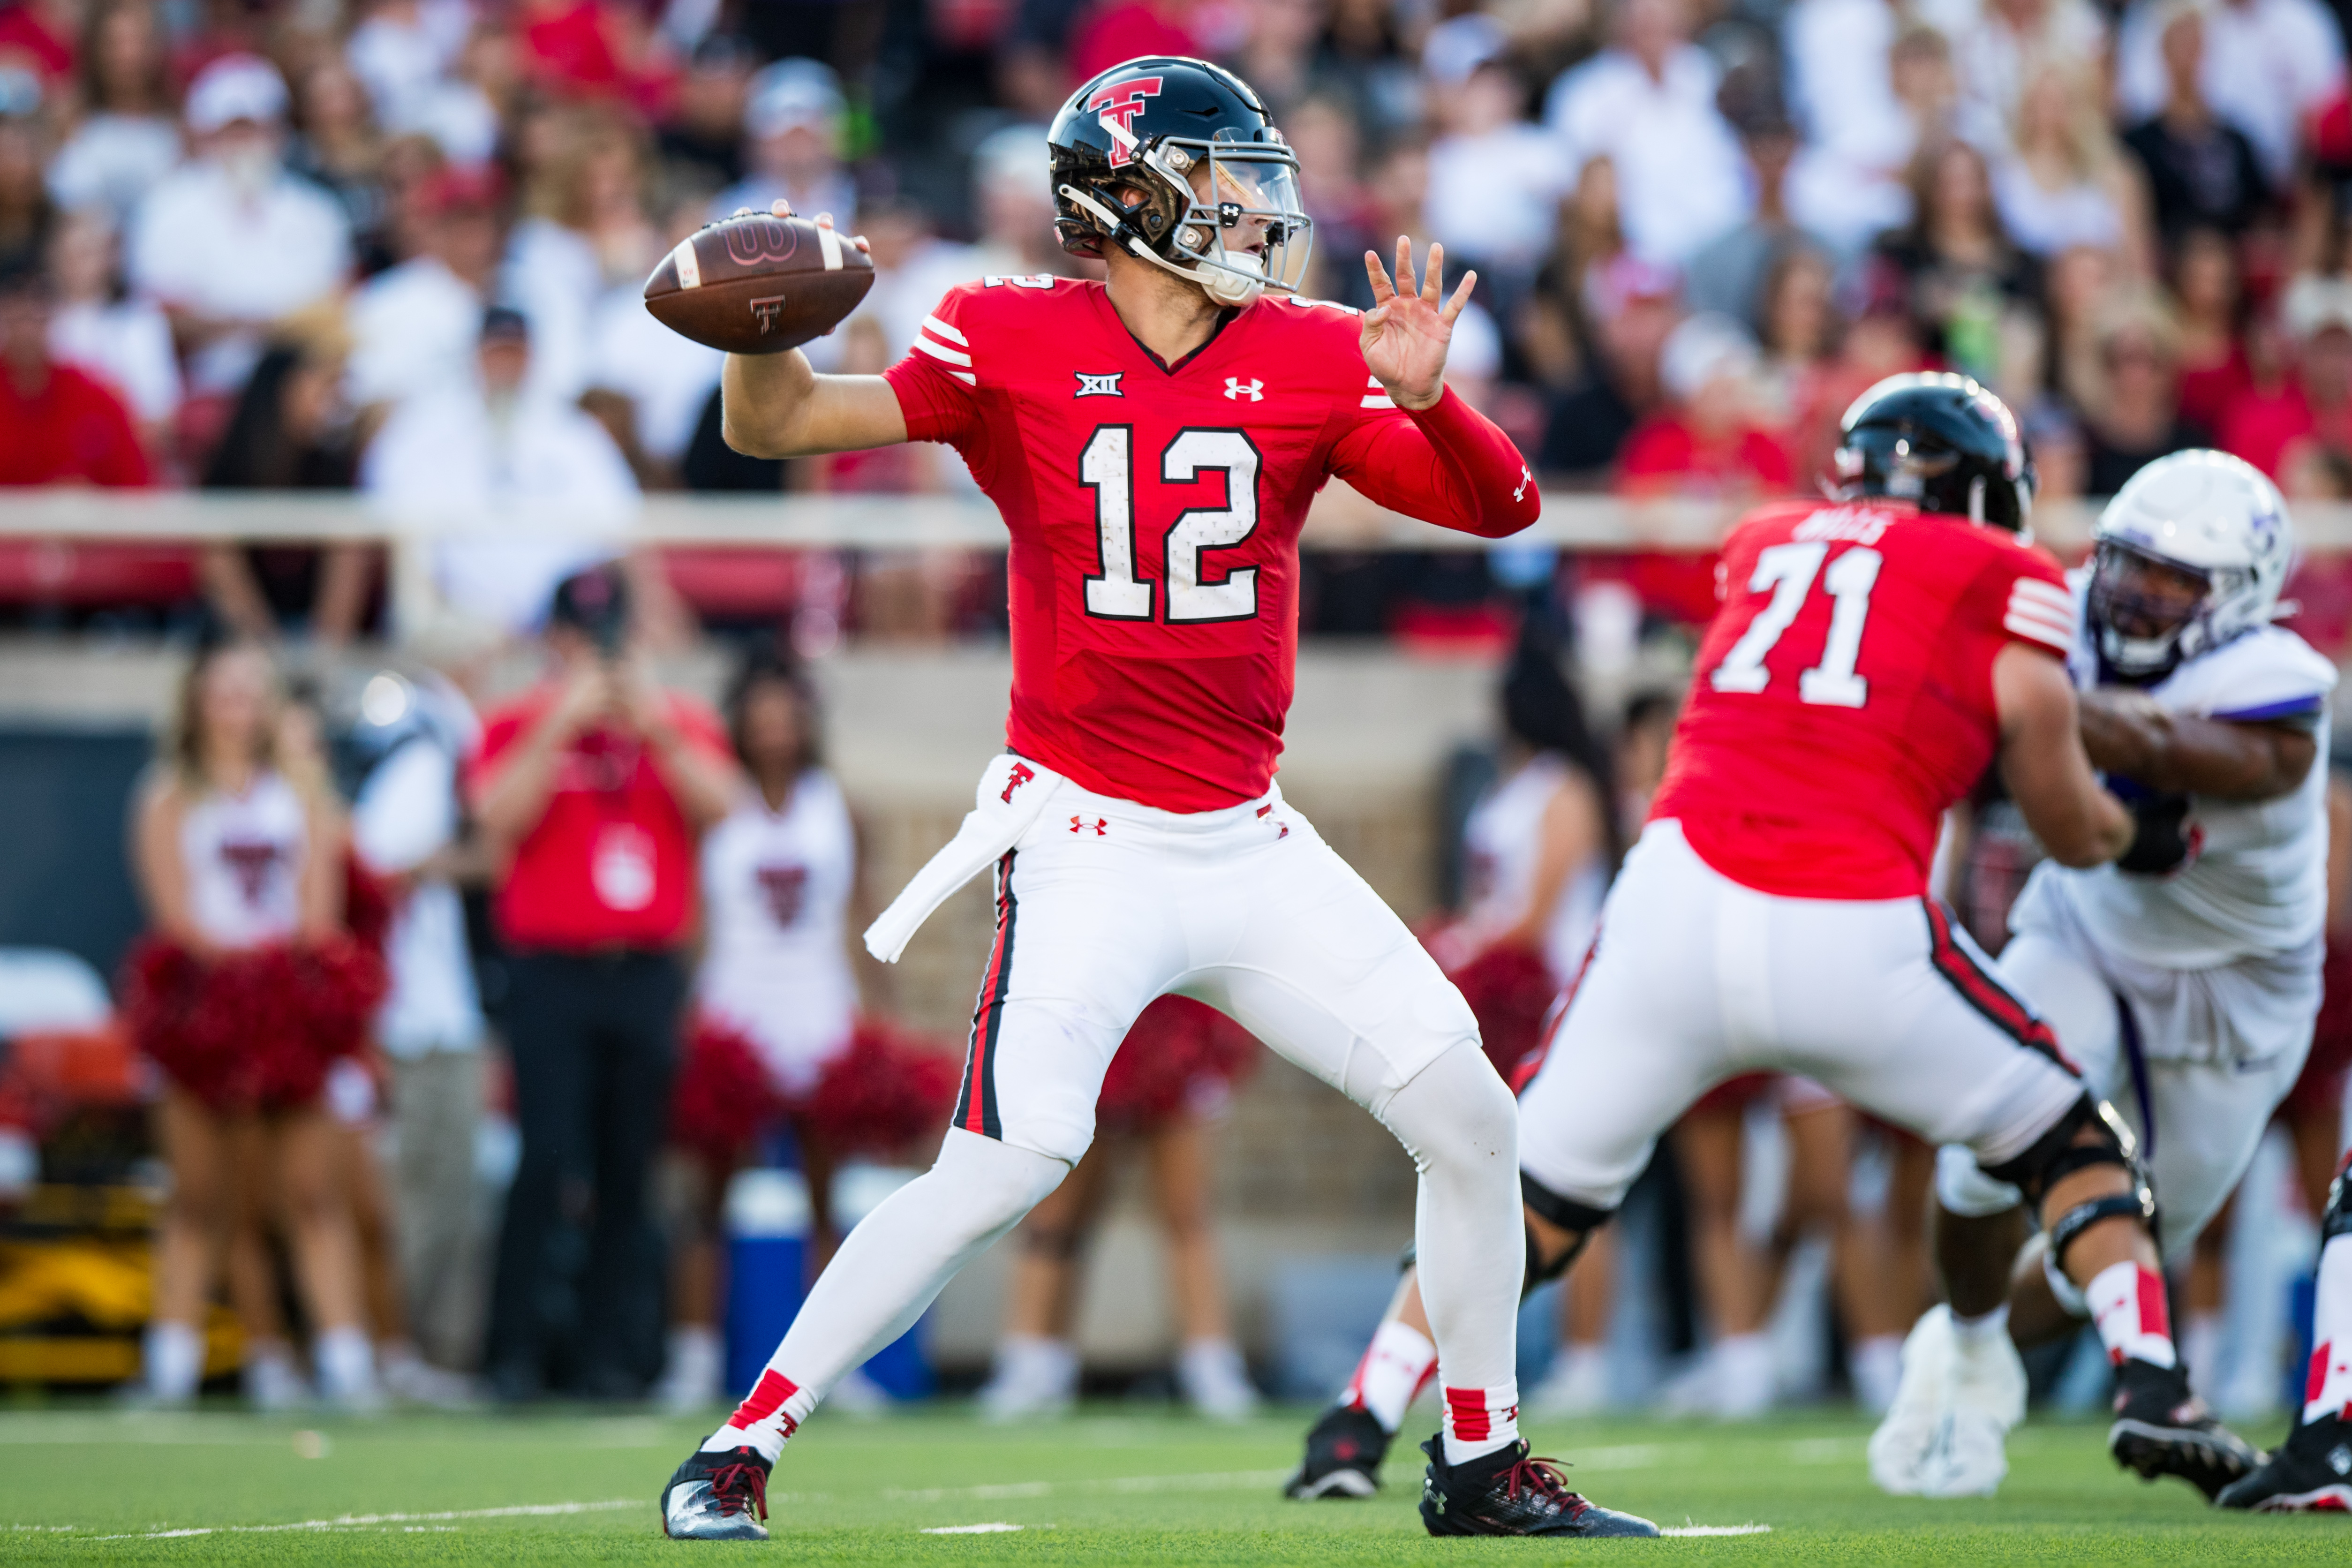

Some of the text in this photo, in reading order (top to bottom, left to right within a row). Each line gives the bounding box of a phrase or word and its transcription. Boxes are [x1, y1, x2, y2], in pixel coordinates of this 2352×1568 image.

[1073, 370, 1125, 400] XII
[1078, 423, 1263, 625] 12
[1710, 541, 1884, 709] 71
